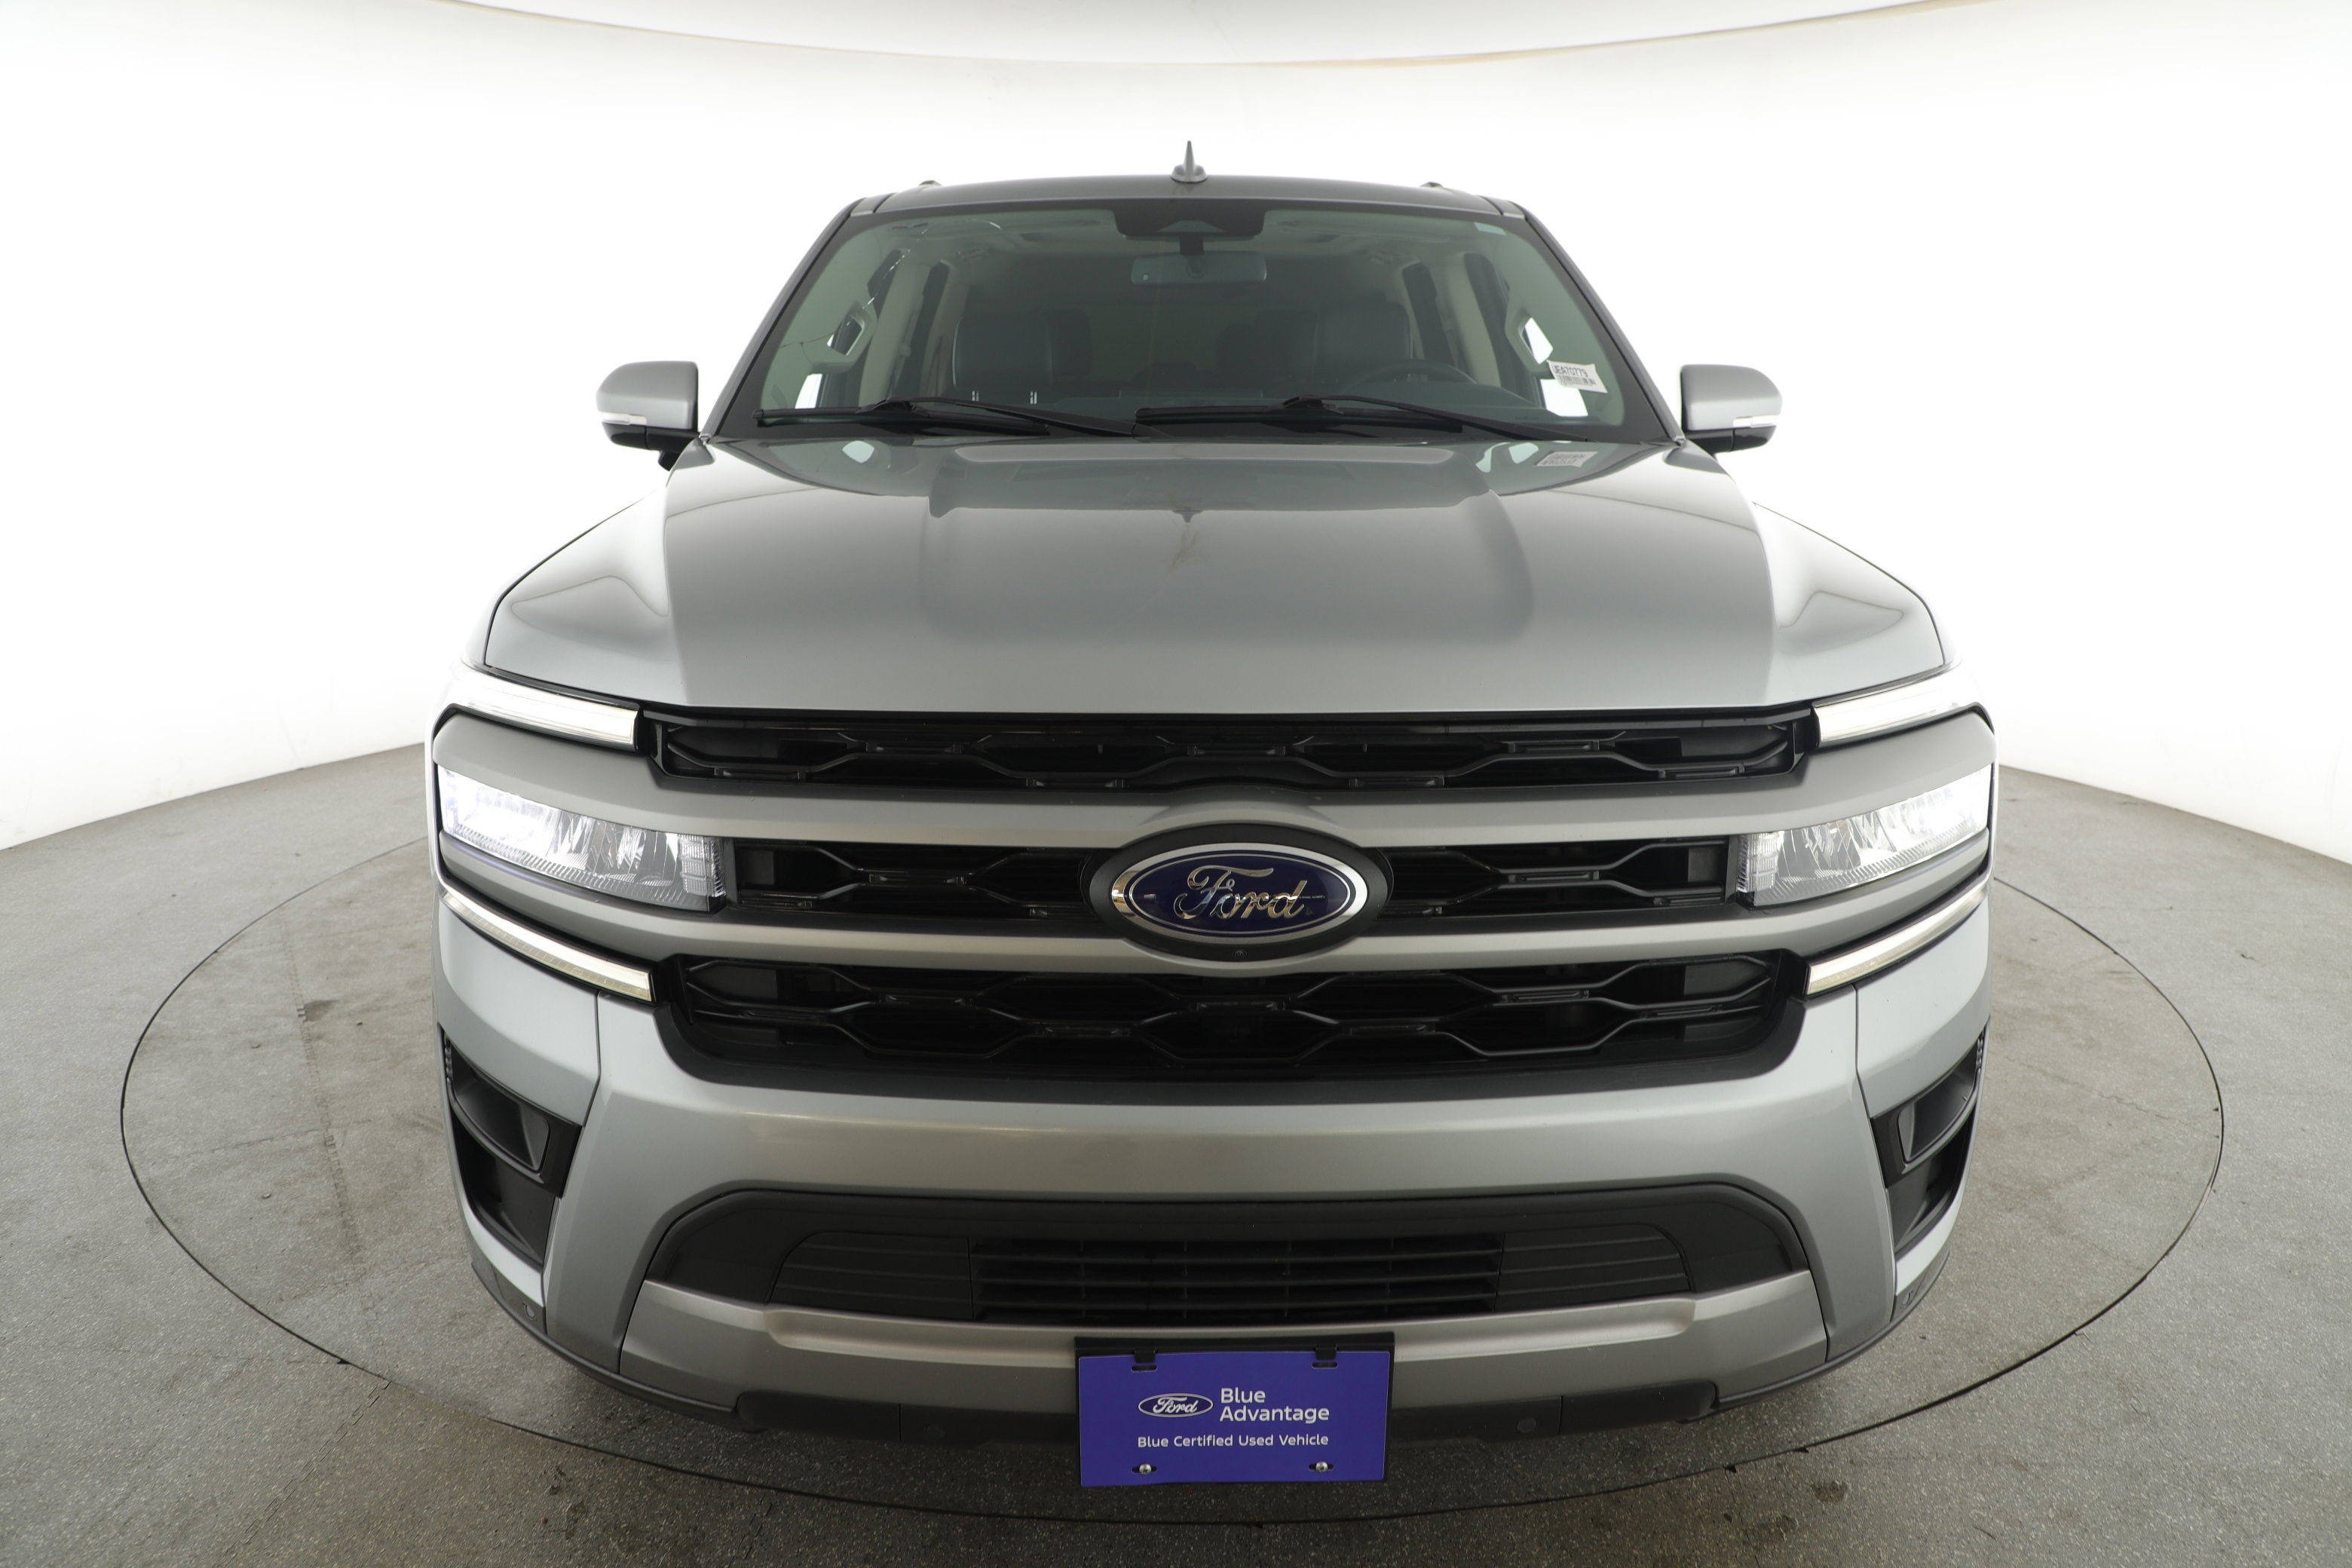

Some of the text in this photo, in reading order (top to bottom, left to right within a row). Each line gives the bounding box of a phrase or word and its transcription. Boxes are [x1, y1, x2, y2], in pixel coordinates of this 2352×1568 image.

[1173, 865, 1308, 919] Ford
[1220, 1387, 1266, 1404] Blue
[1153, 1397, 1199, 1413] Ford
[1219, 1405, 1330, 1424] Advantage
[1138, 1433, 1329, 1447] Blue Certified Used Vehicle
